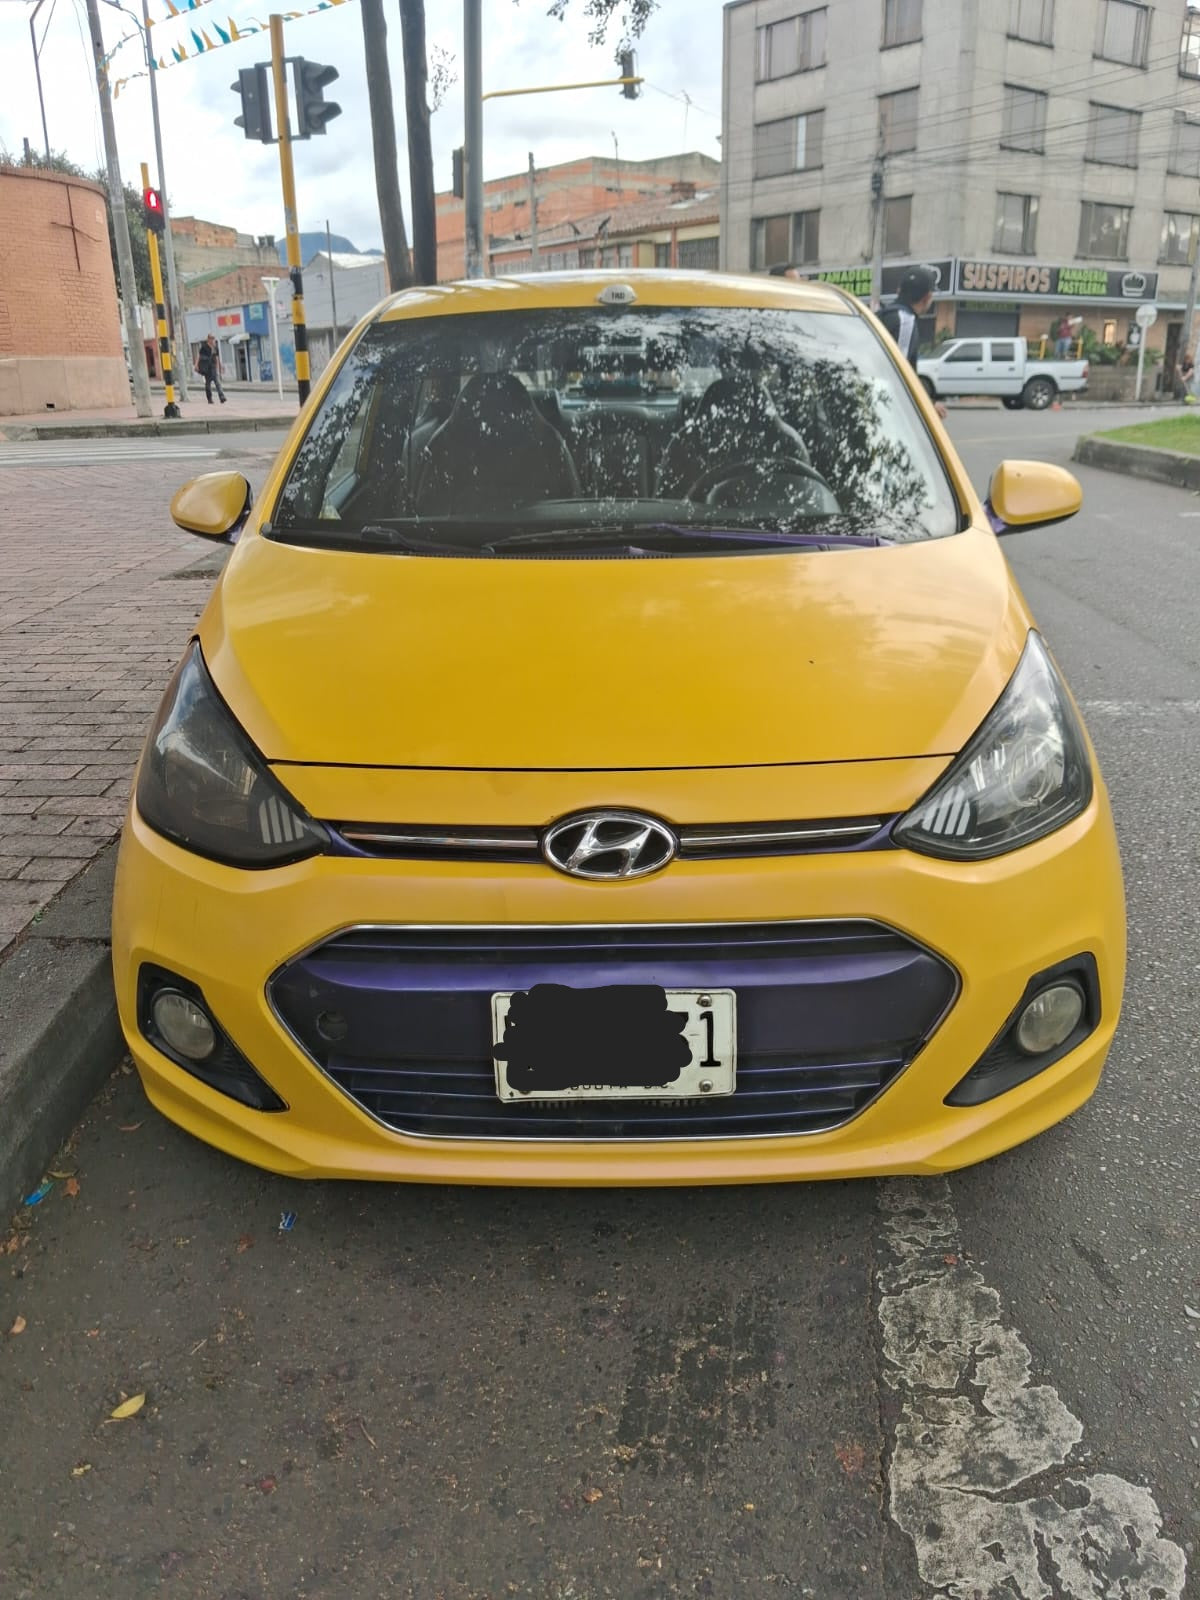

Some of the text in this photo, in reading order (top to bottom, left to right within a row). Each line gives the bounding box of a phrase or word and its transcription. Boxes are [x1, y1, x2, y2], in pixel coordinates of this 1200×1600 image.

[818, 269, 872, 283] PANADERI
[963, 264, 1050, 292] SUSPIROS
[1059, 268, 1107, 282] PANADERIA
[1057, 281, 1107, 295] PASTELERIA
